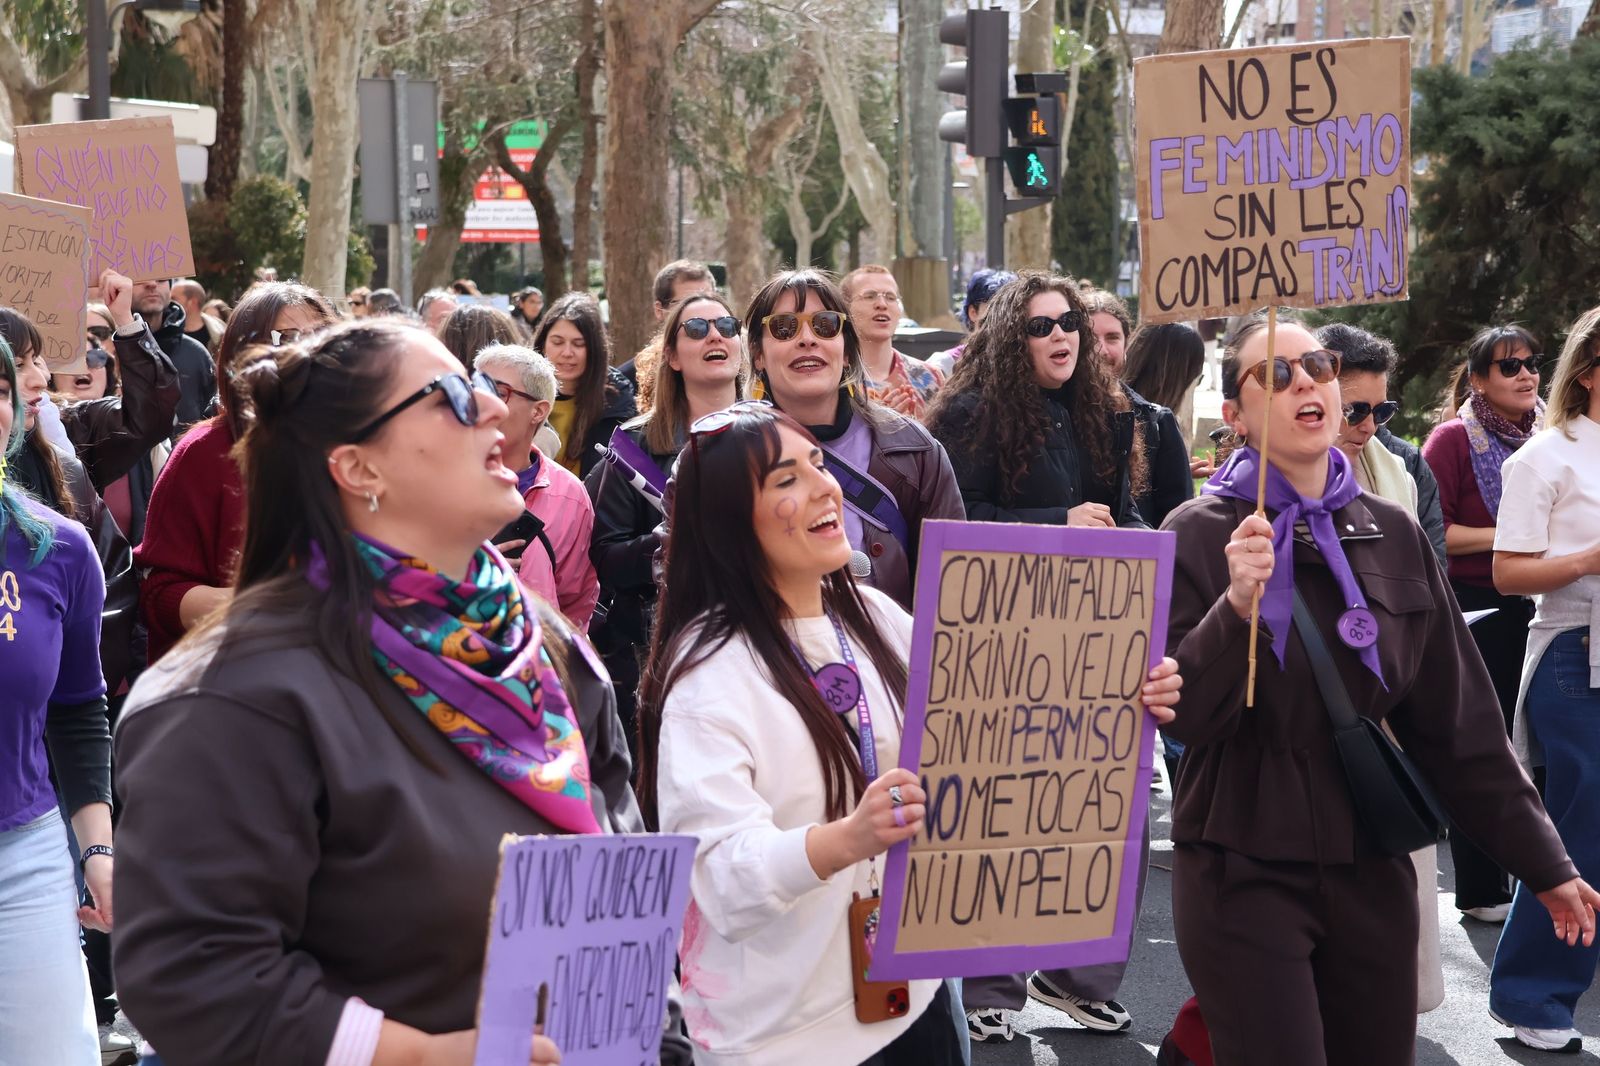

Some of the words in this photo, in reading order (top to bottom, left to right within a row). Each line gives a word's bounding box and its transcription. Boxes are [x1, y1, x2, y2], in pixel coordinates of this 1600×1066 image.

[1199, 57, 1270, 123] NO
[1285, 47, 1337, 125] ES
[36, 138, 115, 193] QUIÉN
[121, 143, 160, 184] NO
[136, 183, 168, 214] NO
[1150, 112, 1403, 220] FEMINISMO
[0, 225, 82, 259] ESTACIÓN
[1204, 188, 1276, 241] SIN
[1299, 178, 1367, 232] LES
[1155, 239, 1298, 312] COMPAS
[1298, 184, 1409, 305] TRANS
[10, 289, 34, 307] LA
[36, 309, 61, 325] DEL
[937, 554, 1014, 627] CON
[1062, 630, 1148, 701] VELO
[911, 772, 963, 845] NO
[959, 773, 1017, 840] ME
[1020, 767, 1126, 835] TOCAS
[532, 843, 582, 928] NOS
[951, 851, 1015, 926] UN
[1014, 844, 1112, 919] PELO
